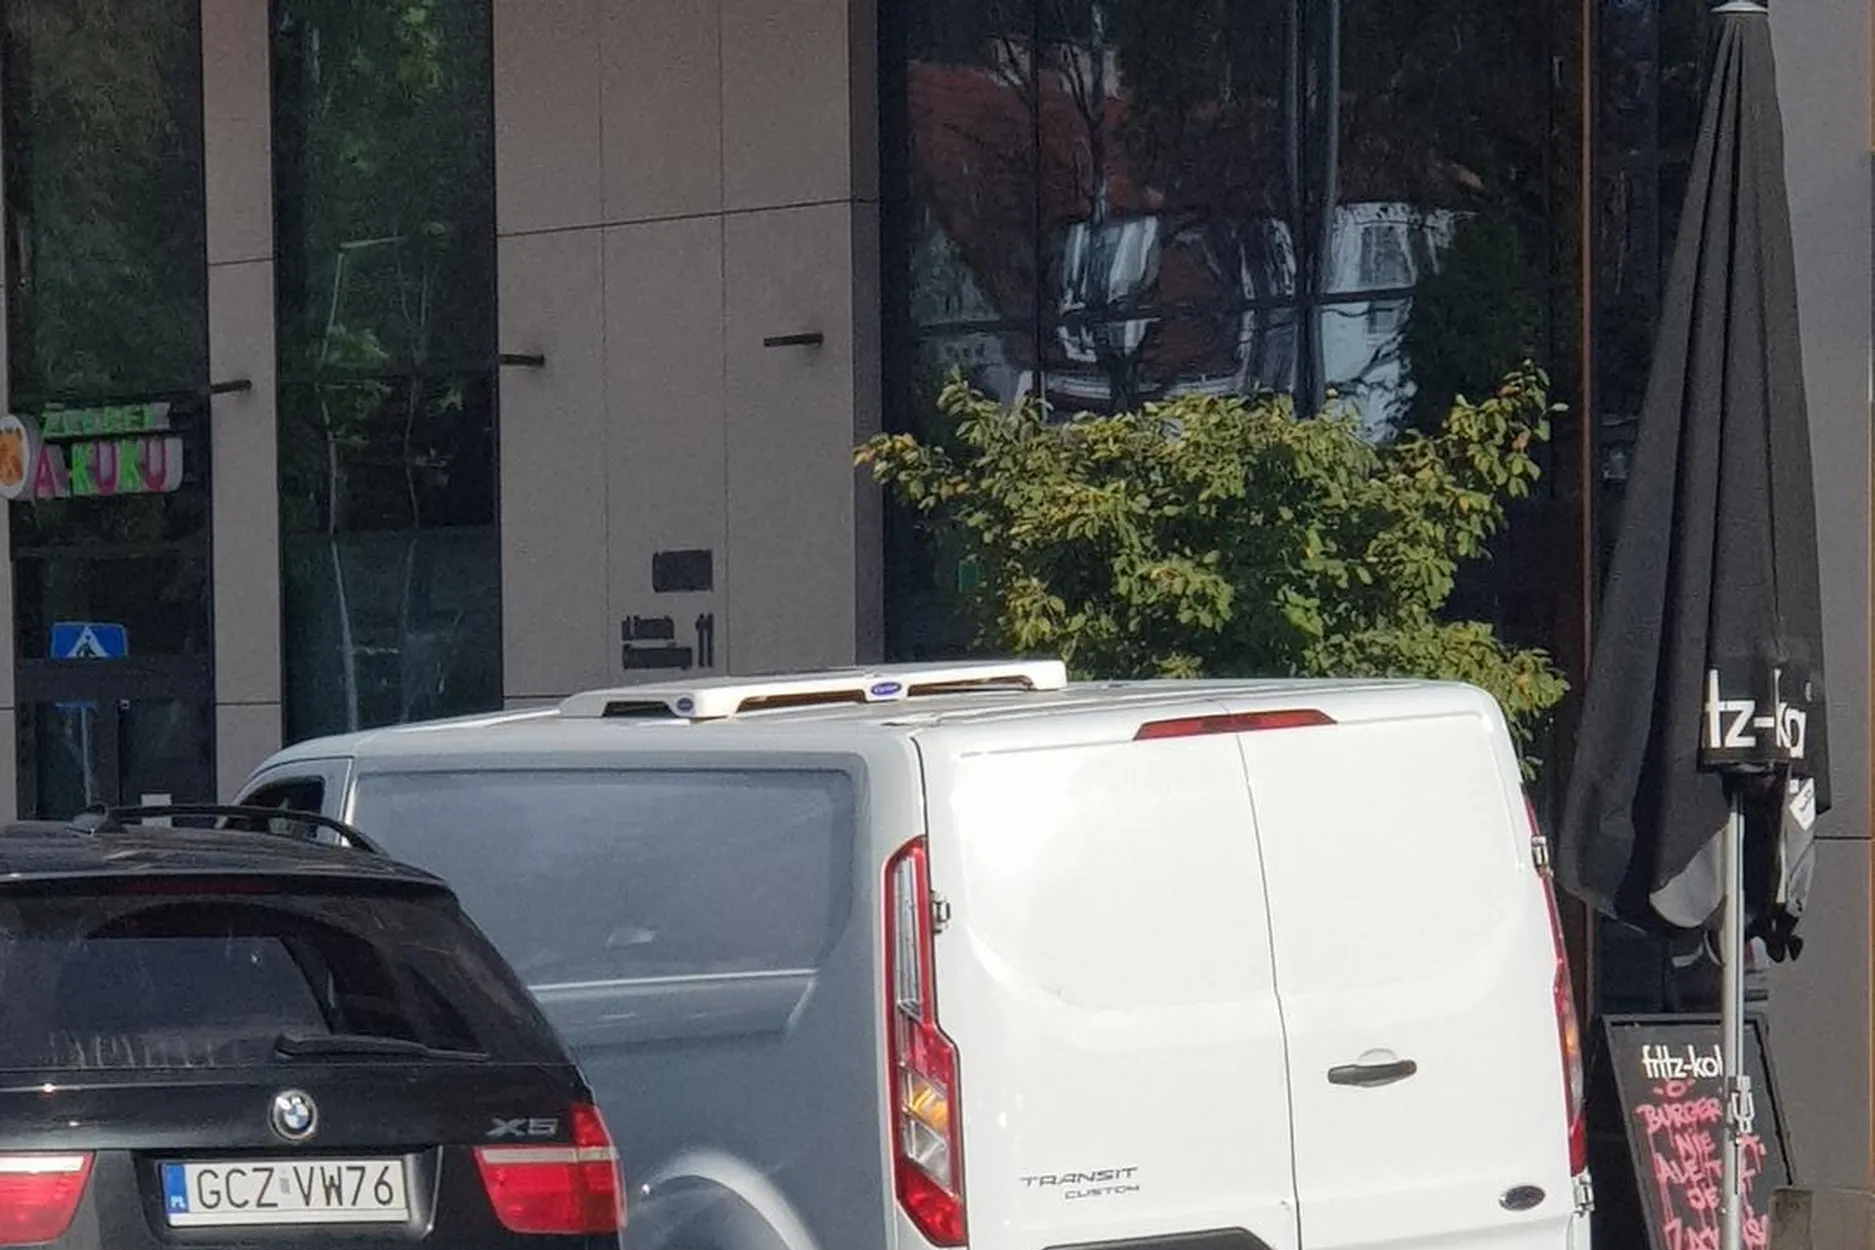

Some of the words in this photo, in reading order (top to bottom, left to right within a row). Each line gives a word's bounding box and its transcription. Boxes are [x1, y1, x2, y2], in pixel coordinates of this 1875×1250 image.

[1641, 1044, 1724, 1078] fritz-kol
[486, 1117, 559, 1137] X5
[196, 1166, 280, 1210] GCZ
[295, 1163, 395, 1207] VW76
[1020, 1167, 1139, 1187] TRANSIT
[1065, 1184, 1140, 1199] CUSTOM
